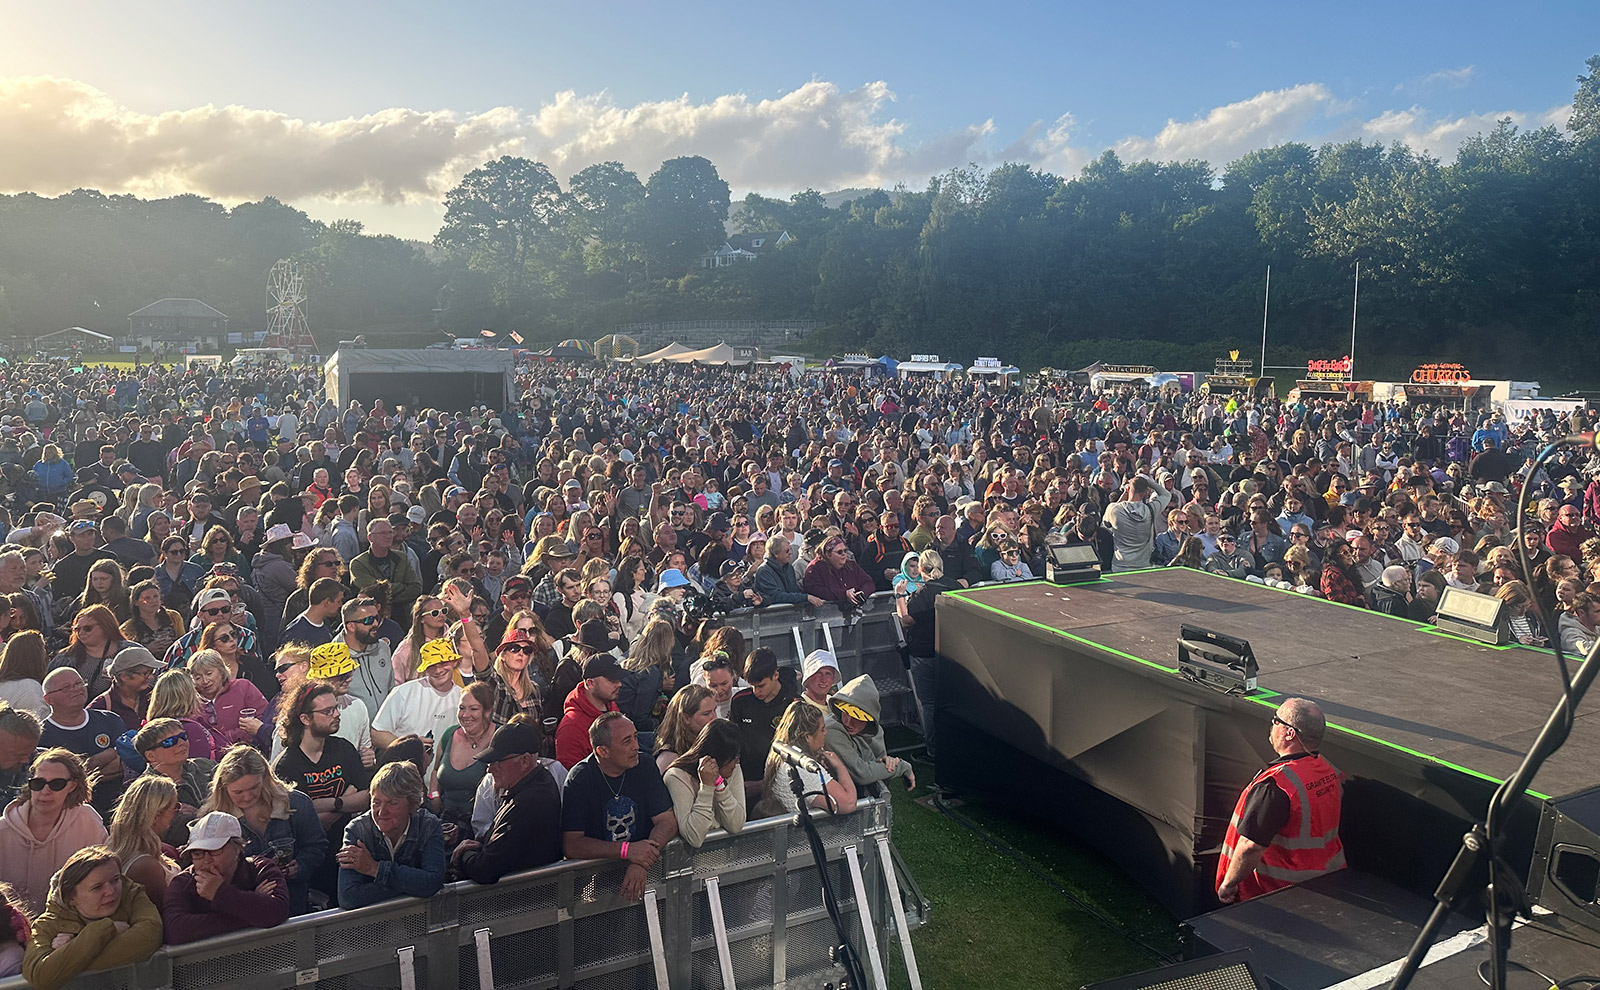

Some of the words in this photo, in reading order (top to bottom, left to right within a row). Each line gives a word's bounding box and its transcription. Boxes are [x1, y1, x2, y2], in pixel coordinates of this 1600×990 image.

[930, 354, 939, 363] PIZZA
[1412, 369, 1471, 383] CHURROS
[1315, 784, 1335, 798] SECURITY
